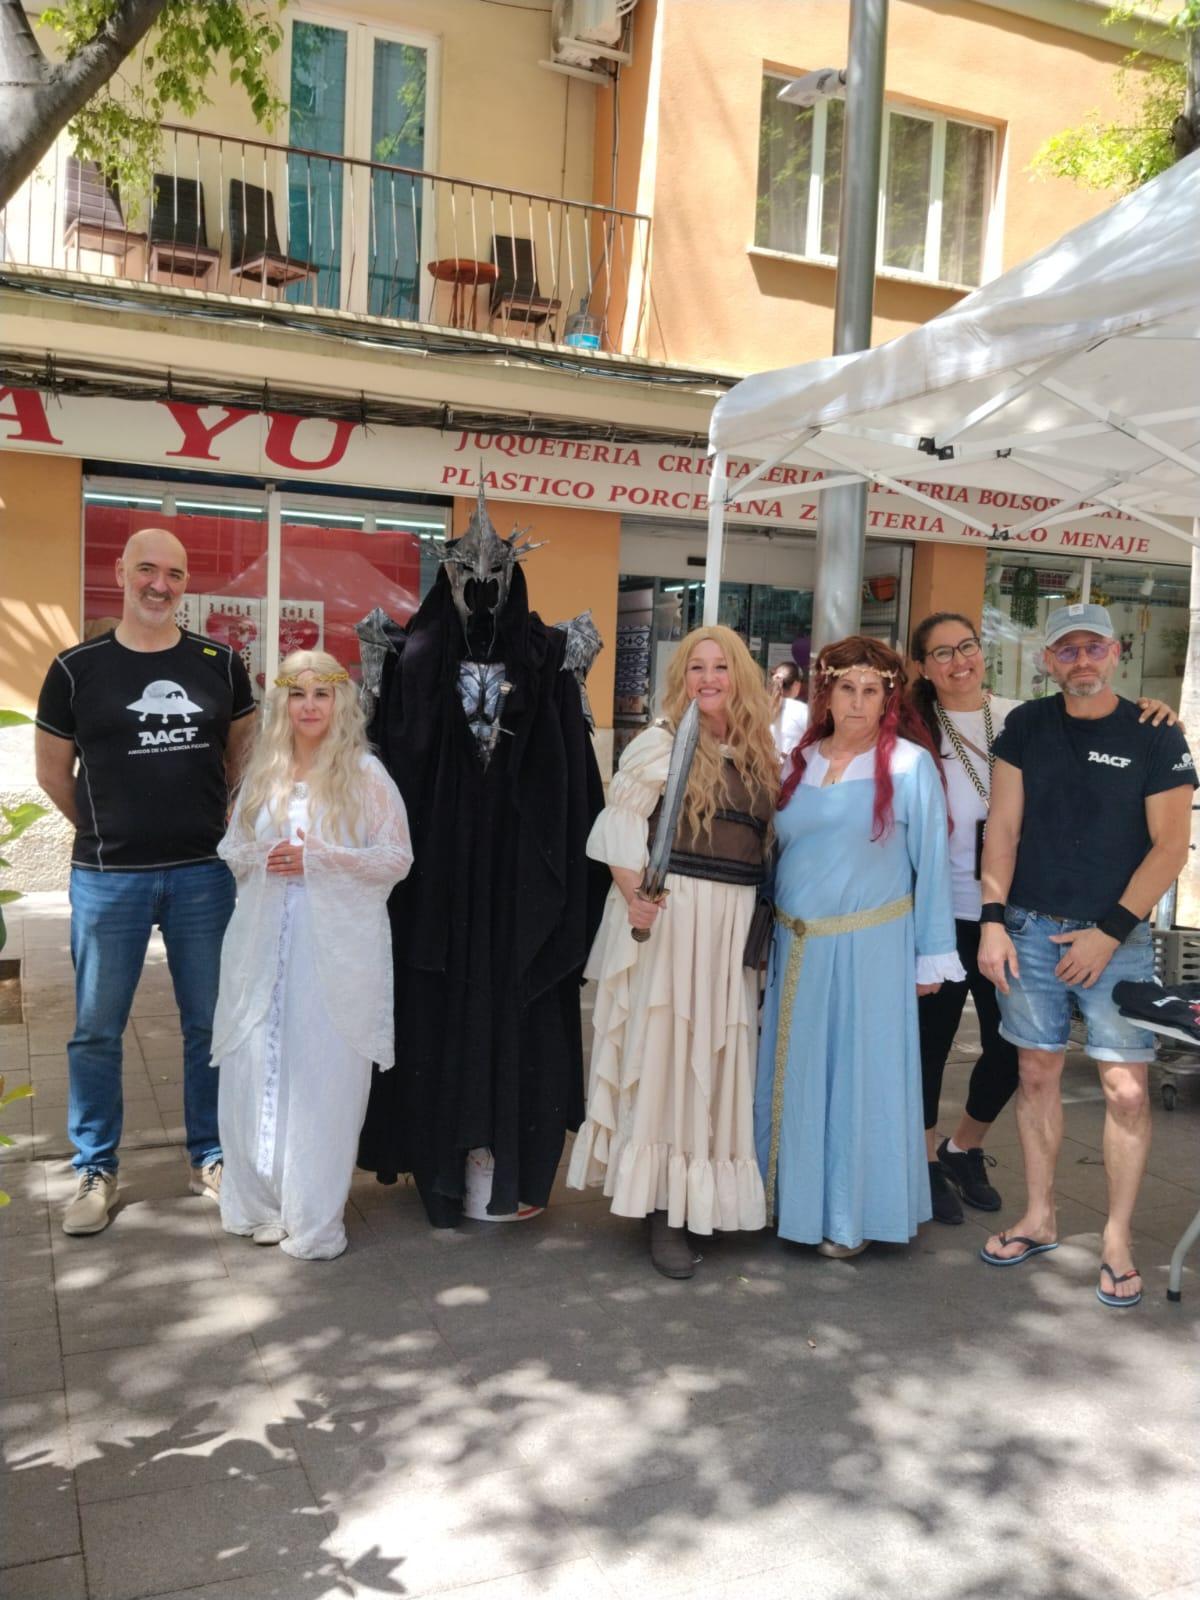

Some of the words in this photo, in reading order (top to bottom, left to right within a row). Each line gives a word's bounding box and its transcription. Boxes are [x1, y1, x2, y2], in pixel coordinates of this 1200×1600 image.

[157, 400, 360, 471] YU
[454, 431, 642, 467] JUQUETERIA
[658, 454, 825, 486] CRISTAERIA
[440, 466, 595, 499] PLASTICO
[608, 485, 784, 518] PORCEANA
[800, 503, 945, 533] ZTERIA
[1059, 530, 1151, 555] MENAJE
[138, 727, 198, 746] AACF
[1088, 751, 1131, 768] AACF
